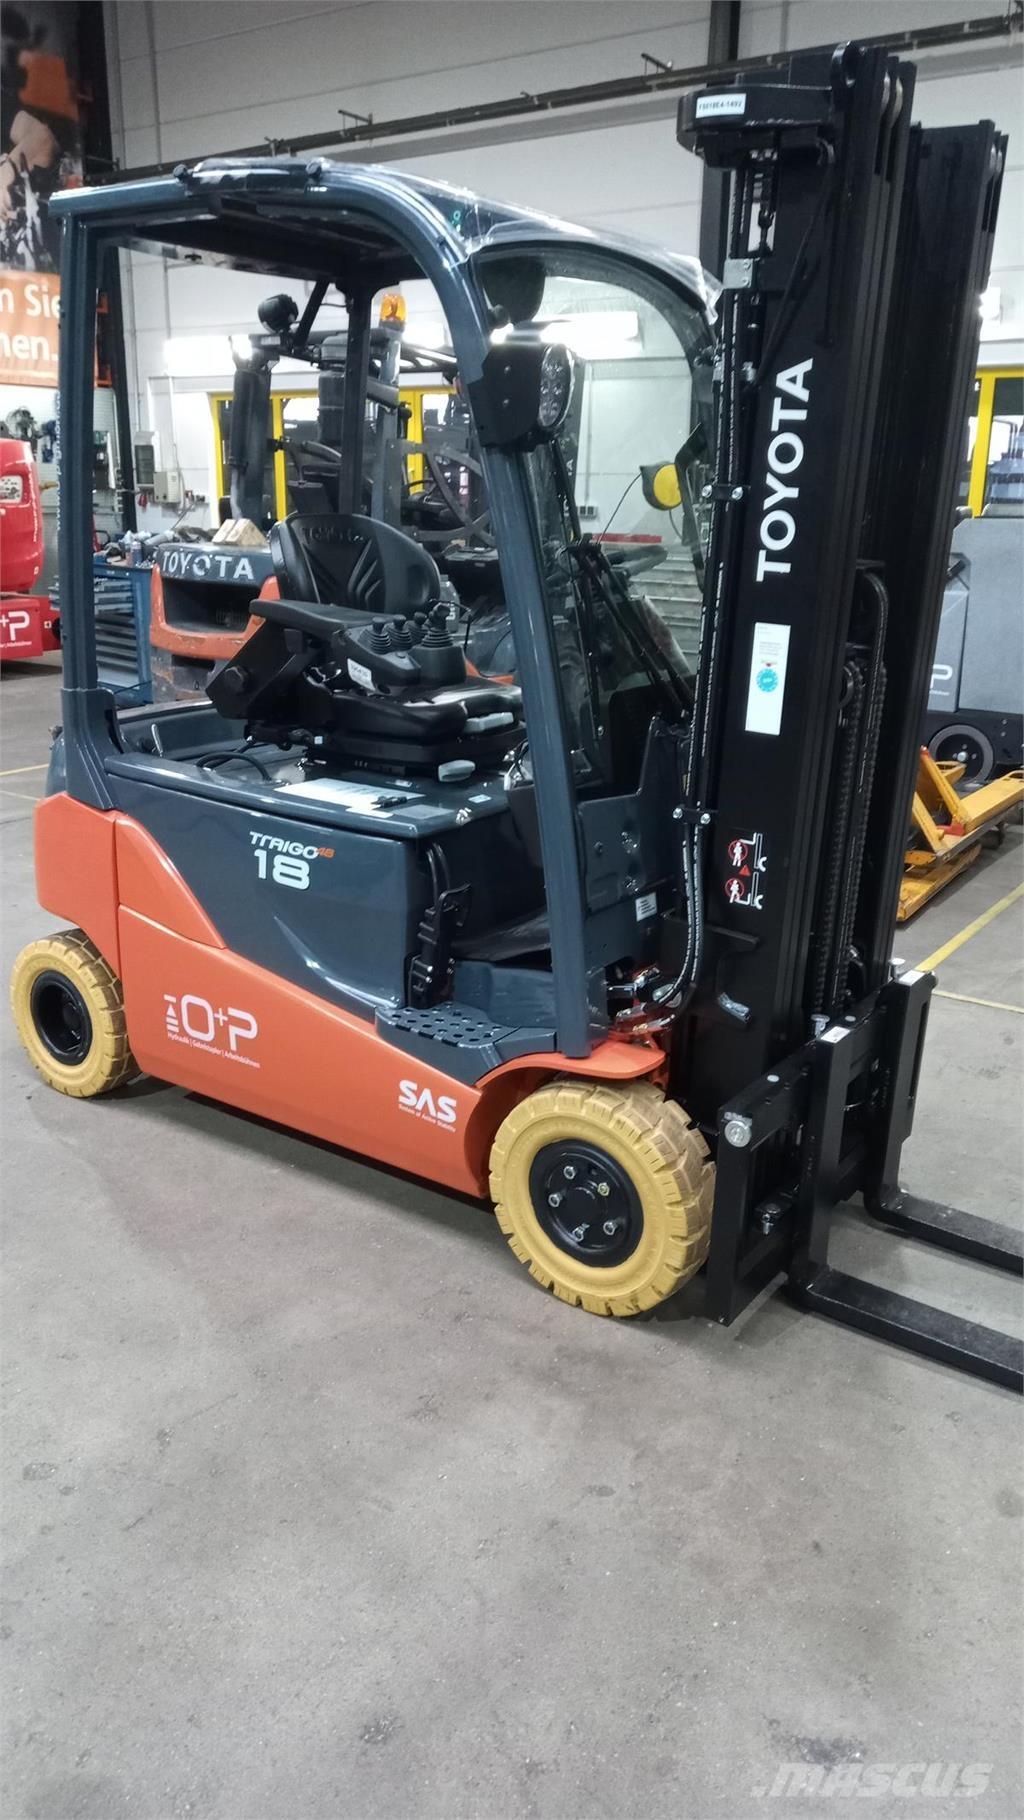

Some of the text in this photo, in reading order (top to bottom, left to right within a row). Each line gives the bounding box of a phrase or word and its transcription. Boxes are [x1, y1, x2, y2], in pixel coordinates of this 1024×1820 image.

[756, 358, 813, 582] TOYOTA
[162, 550, 254, 580] TOYOTA
[254, 848, 310, 890] 18
[398, 1079, 457, 1123] SAS
